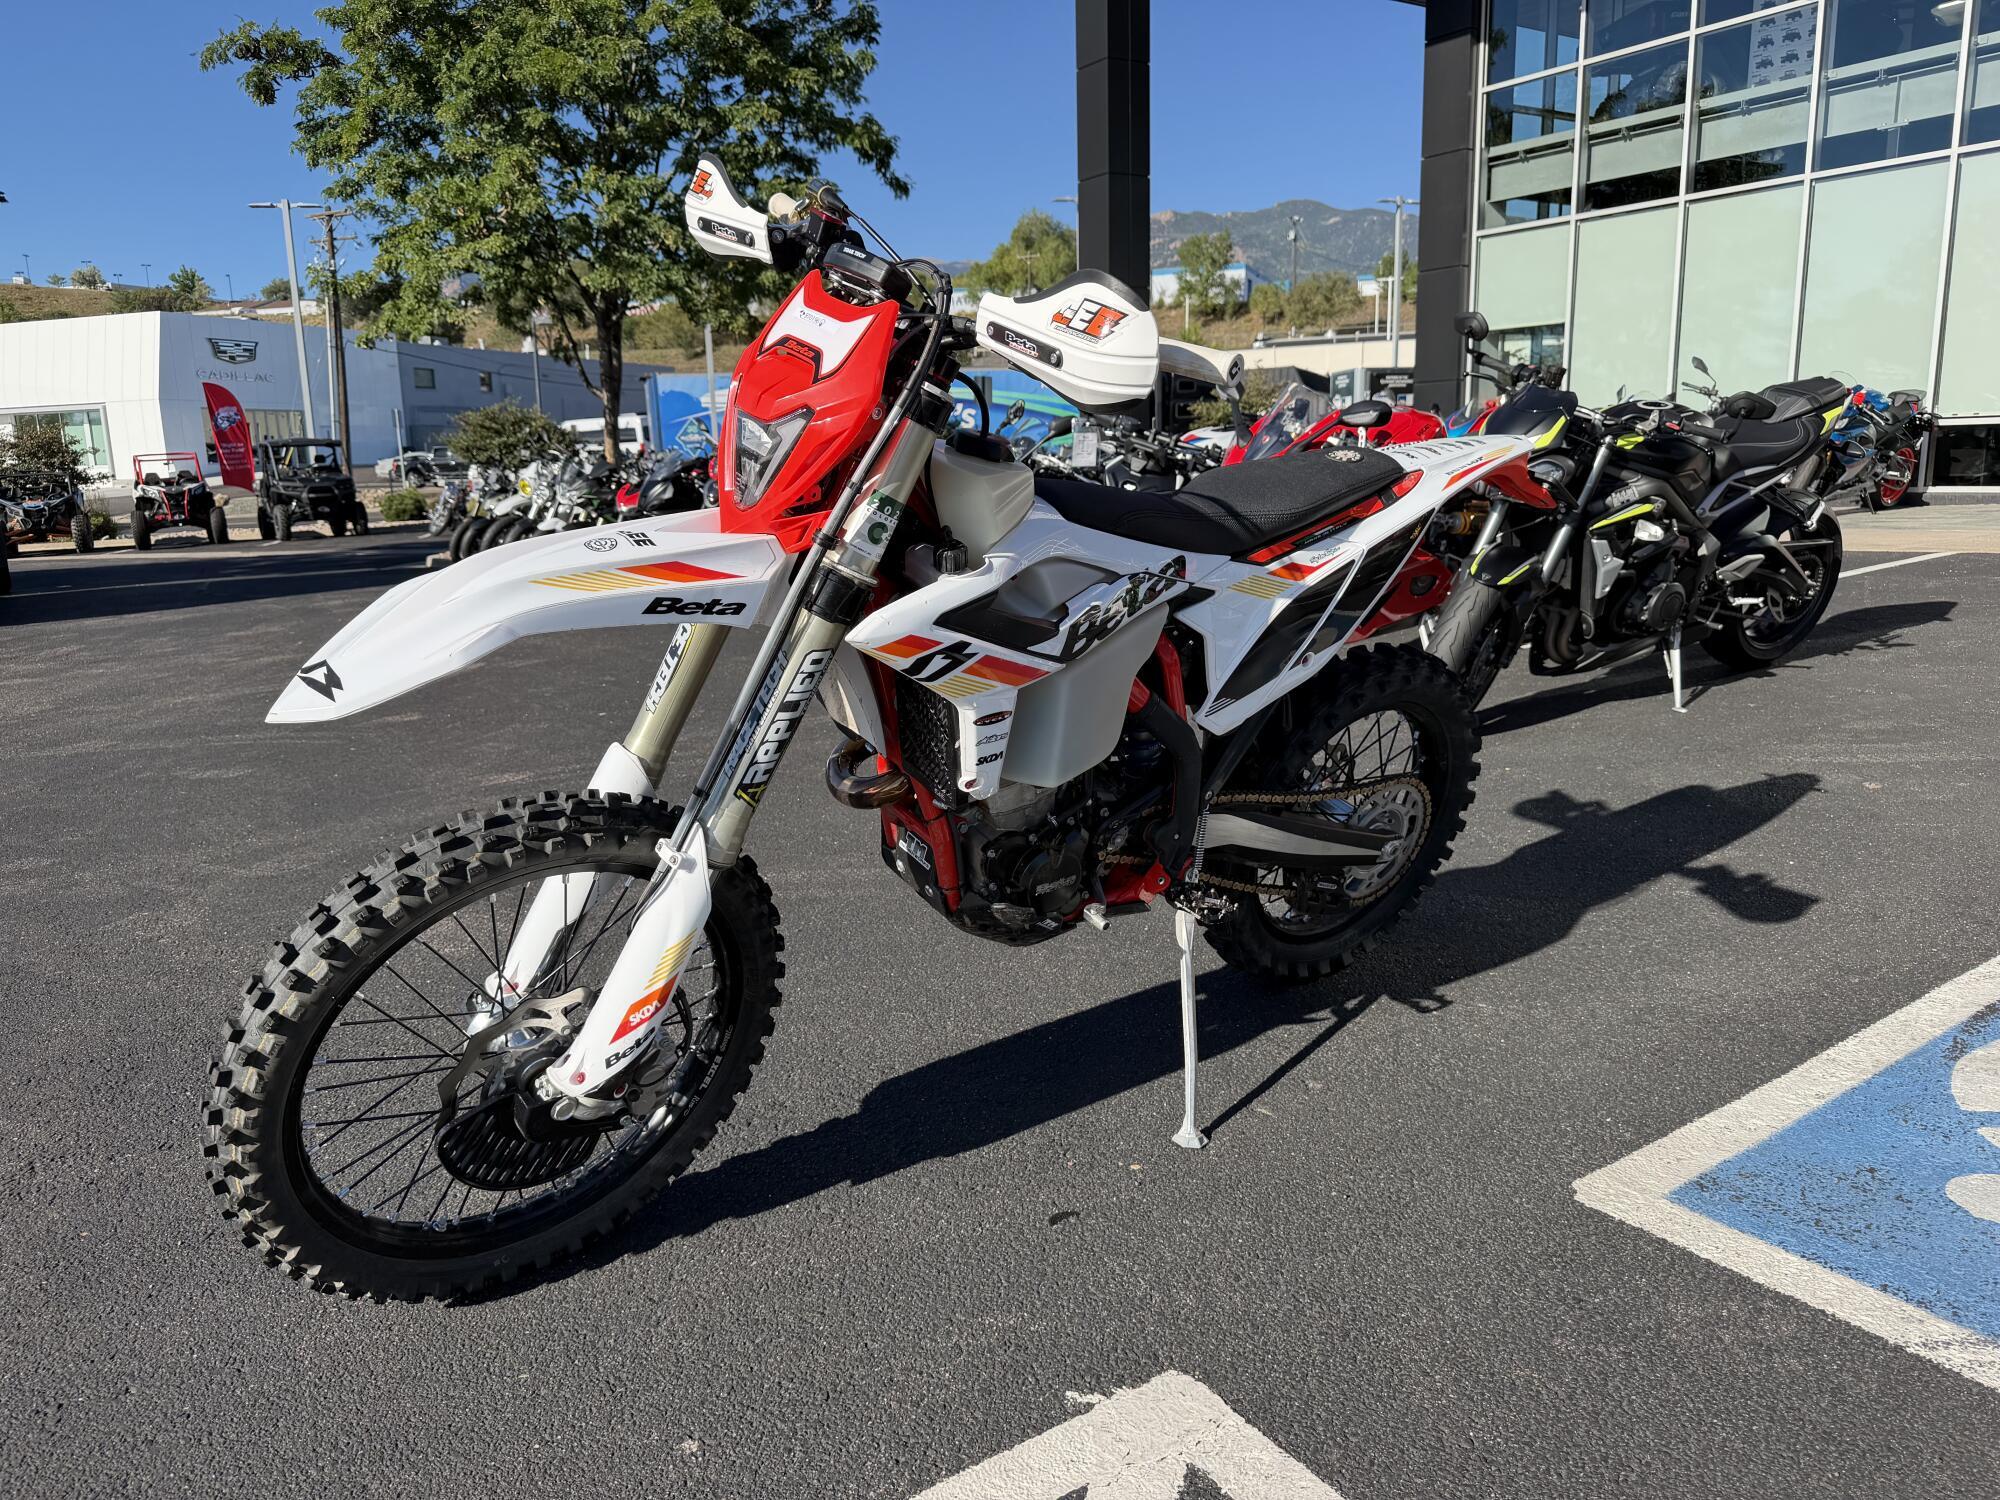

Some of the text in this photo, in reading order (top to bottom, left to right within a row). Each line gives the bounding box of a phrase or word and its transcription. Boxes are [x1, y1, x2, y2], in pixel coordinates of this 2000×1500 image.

[711, 222, 736, 238] Beta
[784, 339, 816, 358] Beta
[1005, 330, 1037, 352] Beta
[196, 367, 274, 383] CADILLAC
[641, 597, 747, 616] Beta
[1060, 555, 1186, 661] Beta
[754, 649, 788, 713] TECH
[742, 650, 832, 784] APPLIED
[605, 1026, 656, 1070] Beta
[699, 1055, 723, 1089] EXCEL
